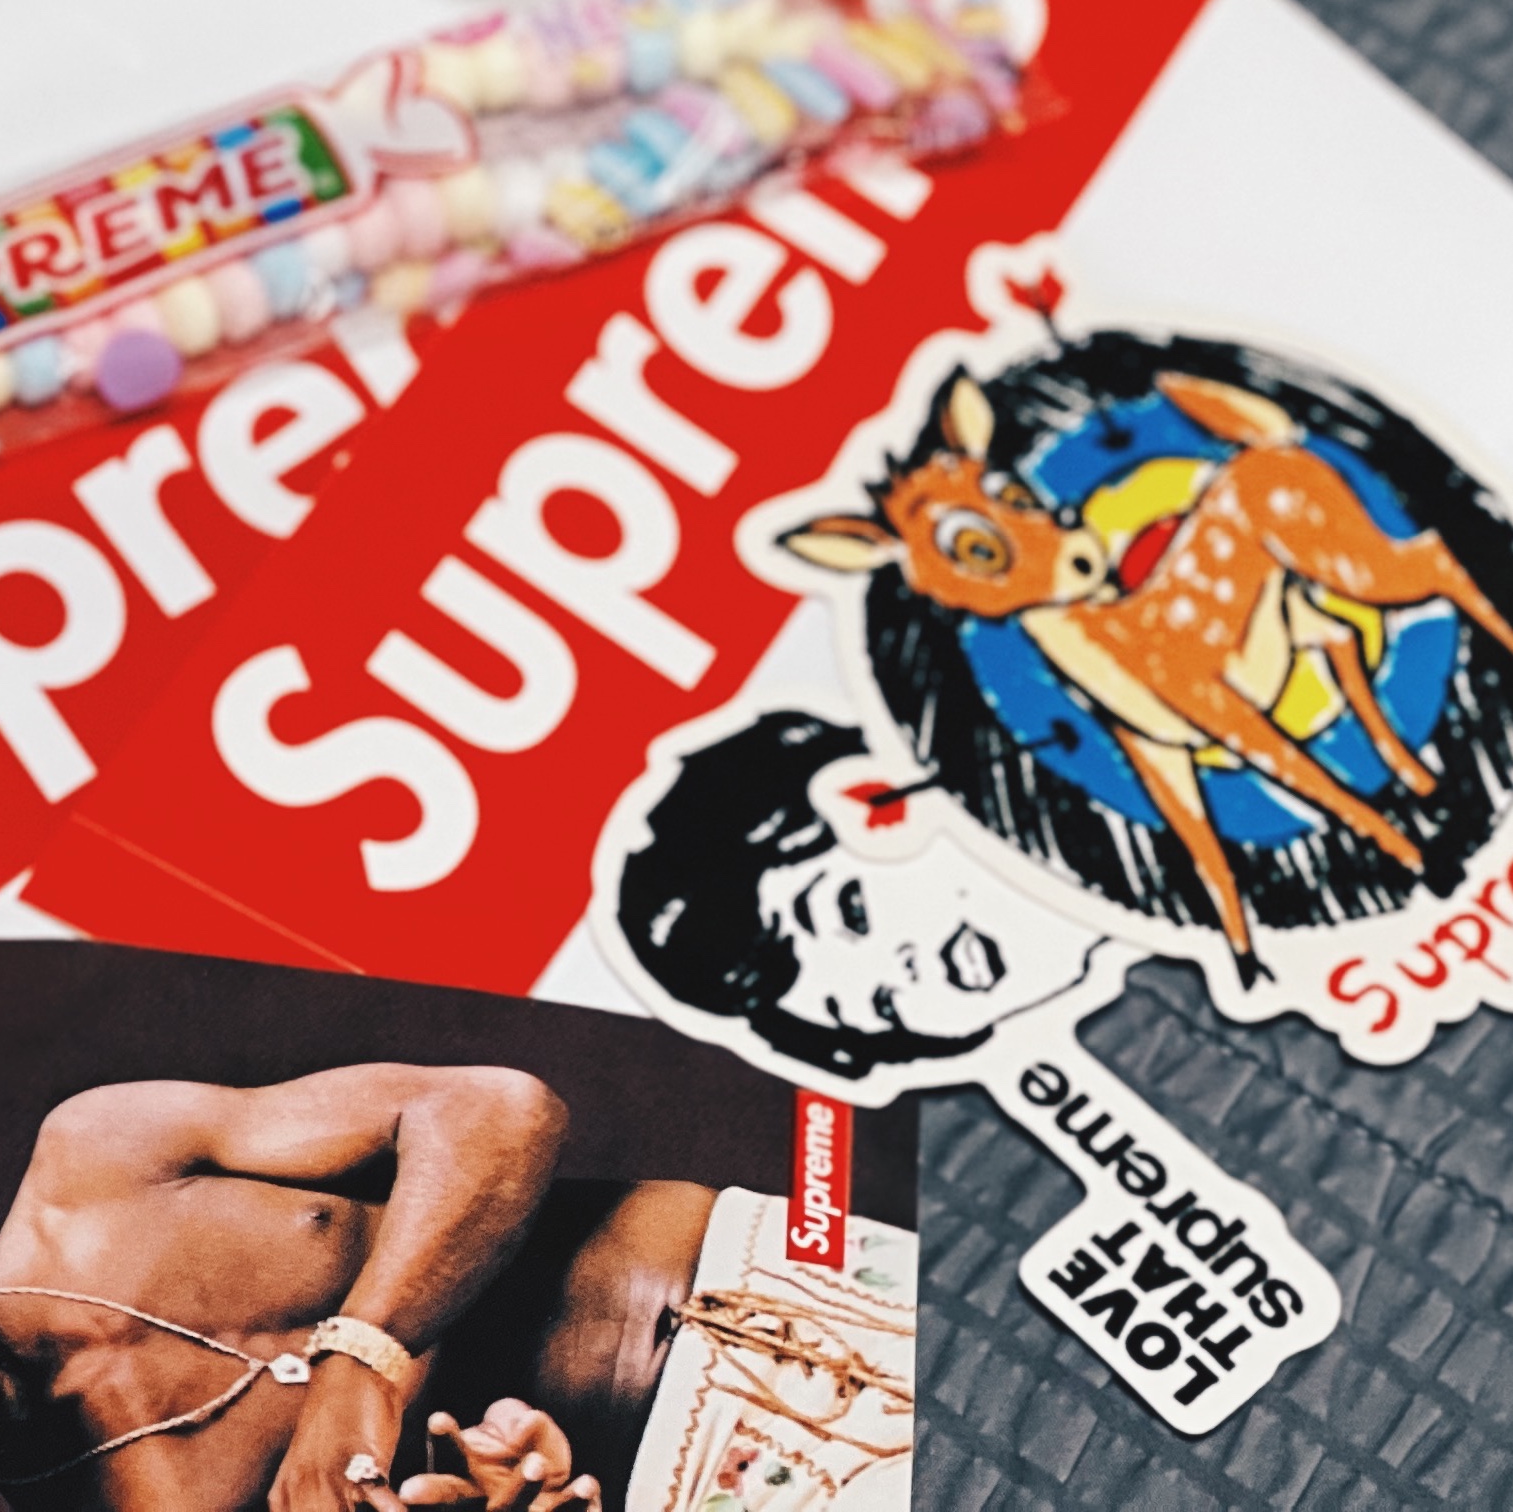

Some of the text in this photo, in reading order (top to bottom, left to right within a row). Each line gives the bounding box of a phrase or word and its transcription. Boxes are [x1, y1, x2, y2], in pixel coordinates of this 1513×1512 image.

[1327, 855, 1513, 1034] Supr
[790, 1101, 842, 1255] Supreme
[1048, 1248, 1220, 1406] LOVE
[1091, 1220, 1253, 1373] THAT
